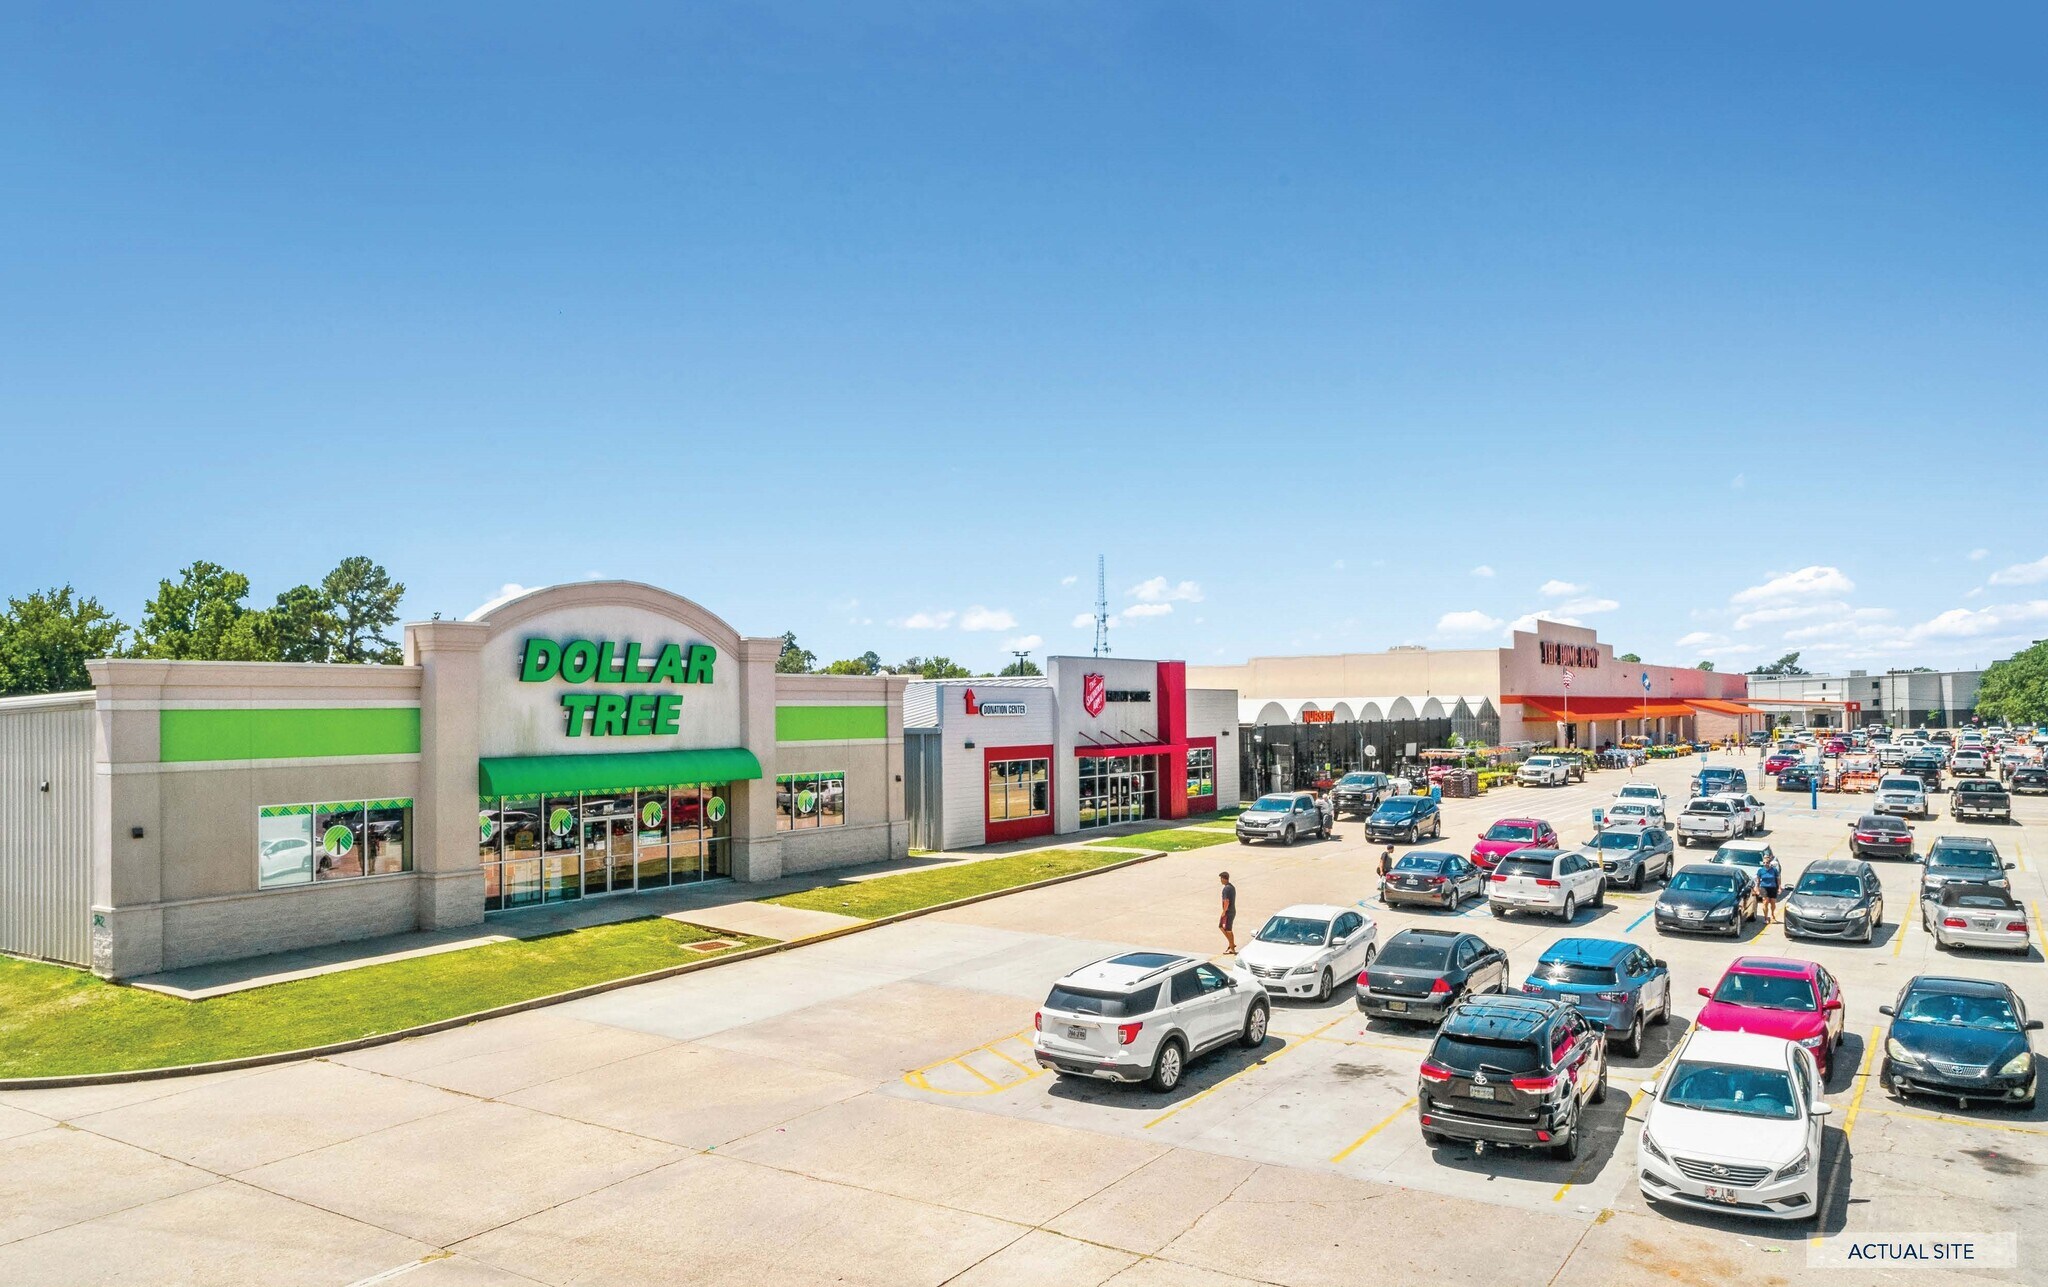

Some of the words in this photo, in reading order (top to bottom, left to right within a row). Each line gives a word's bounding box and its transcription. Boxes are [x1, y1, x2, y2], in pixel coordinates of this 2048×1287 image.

[519, 638, 717, 684] DOLLAR
[1542, 641, 1558, 665] THE
[1559, 643, 1579, 667] HOME
[1580, 646, 1600, 668] DEPOT
[560, 694, 683, 737] TREE
[983, 705, 1008, 714] DONATION
[1008, 705, 1026, 714] CENTER
[1302, 710, 1335, 723] NURSERY
